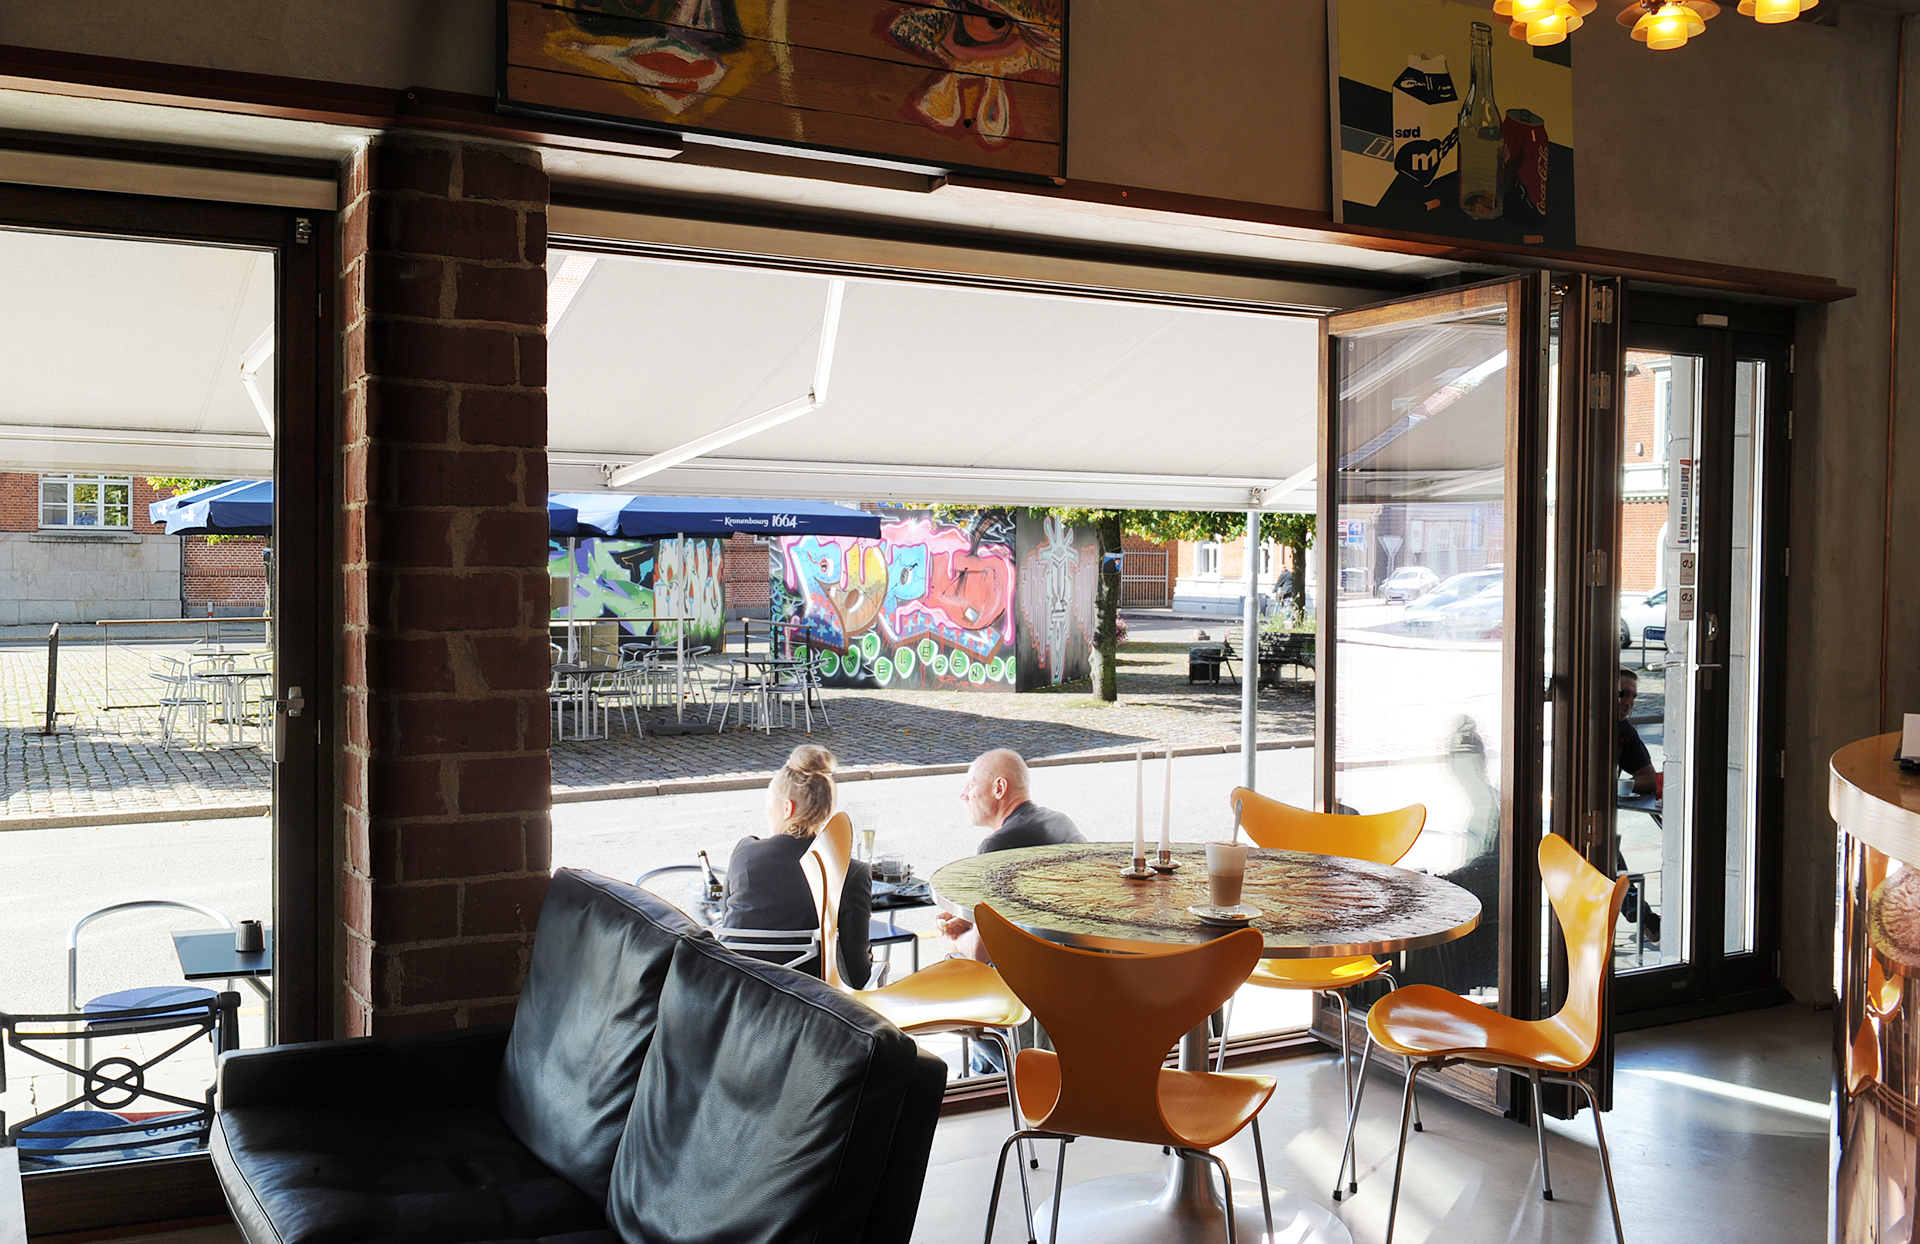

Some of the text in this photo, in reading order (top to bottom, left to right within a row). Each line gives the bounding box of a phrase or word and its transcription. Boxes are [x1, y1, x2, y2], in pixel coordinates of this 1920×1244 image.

[1395, 126, 1421, 138] sød
[724, 513, 798, 529] Kronenbourg 1664
